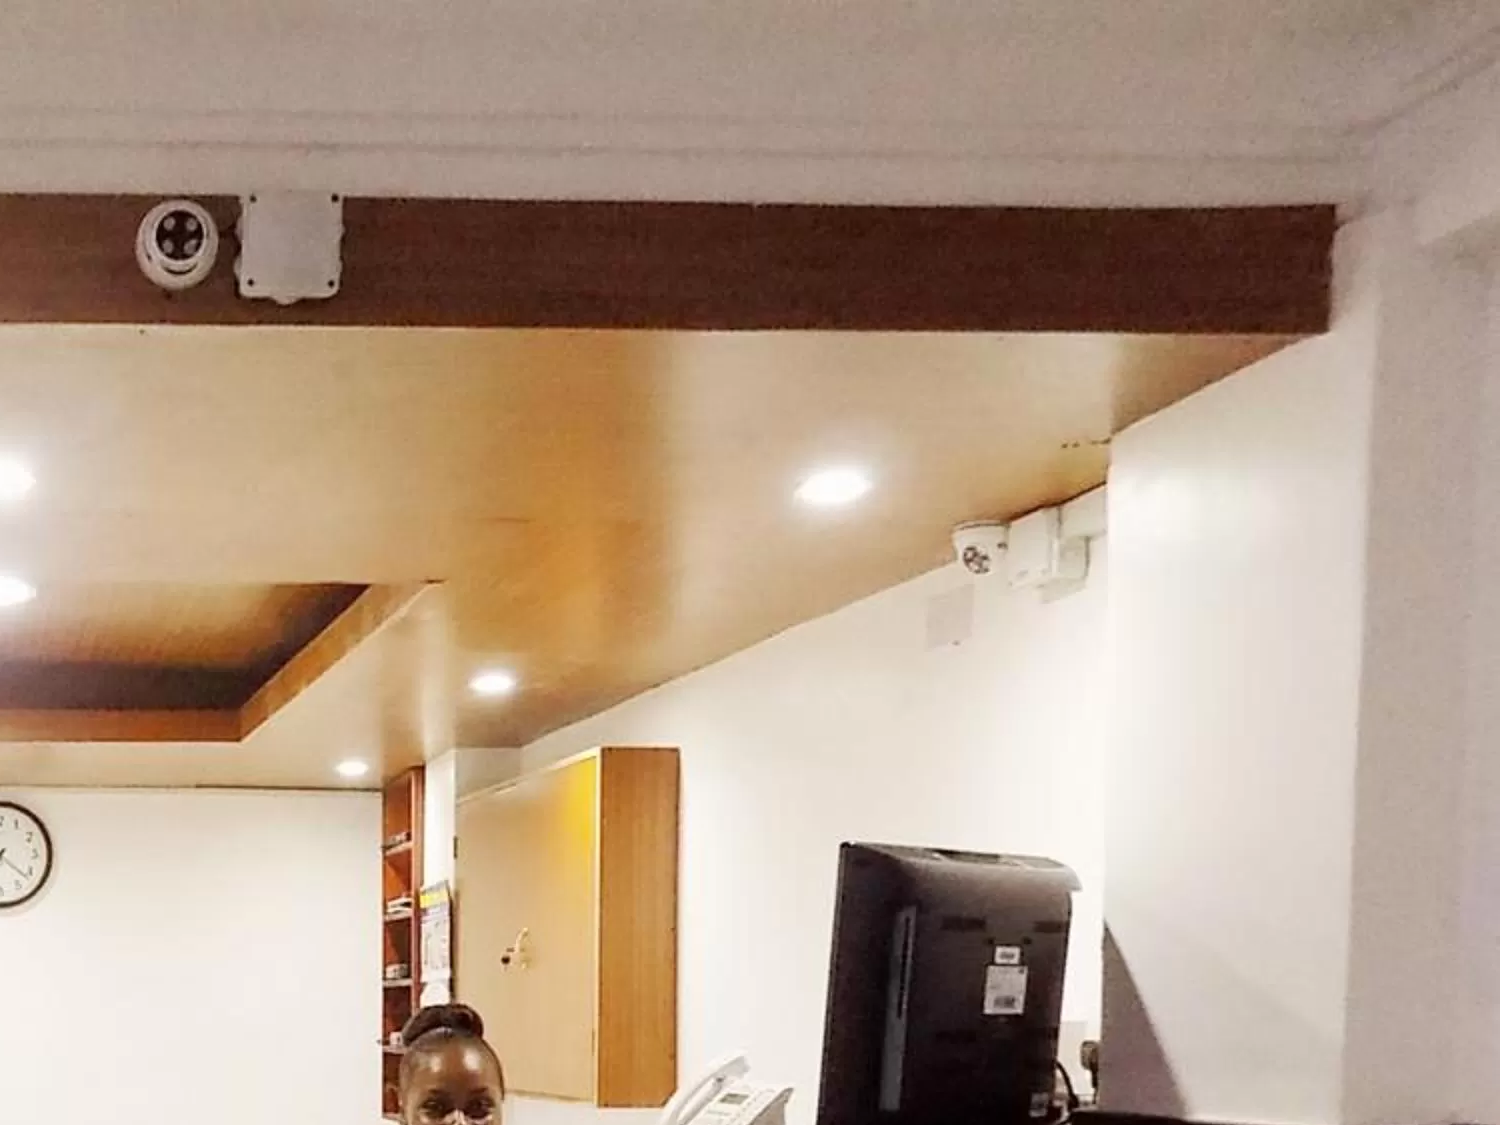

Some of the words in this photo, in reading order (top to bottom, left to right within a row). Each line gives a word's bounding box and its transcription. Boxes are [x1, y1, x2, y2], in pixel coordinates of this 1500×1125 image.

[13, 819, 19, 830] 1
[25, 831, 34, 843] 2
[30, 848, 39, 860] 3
